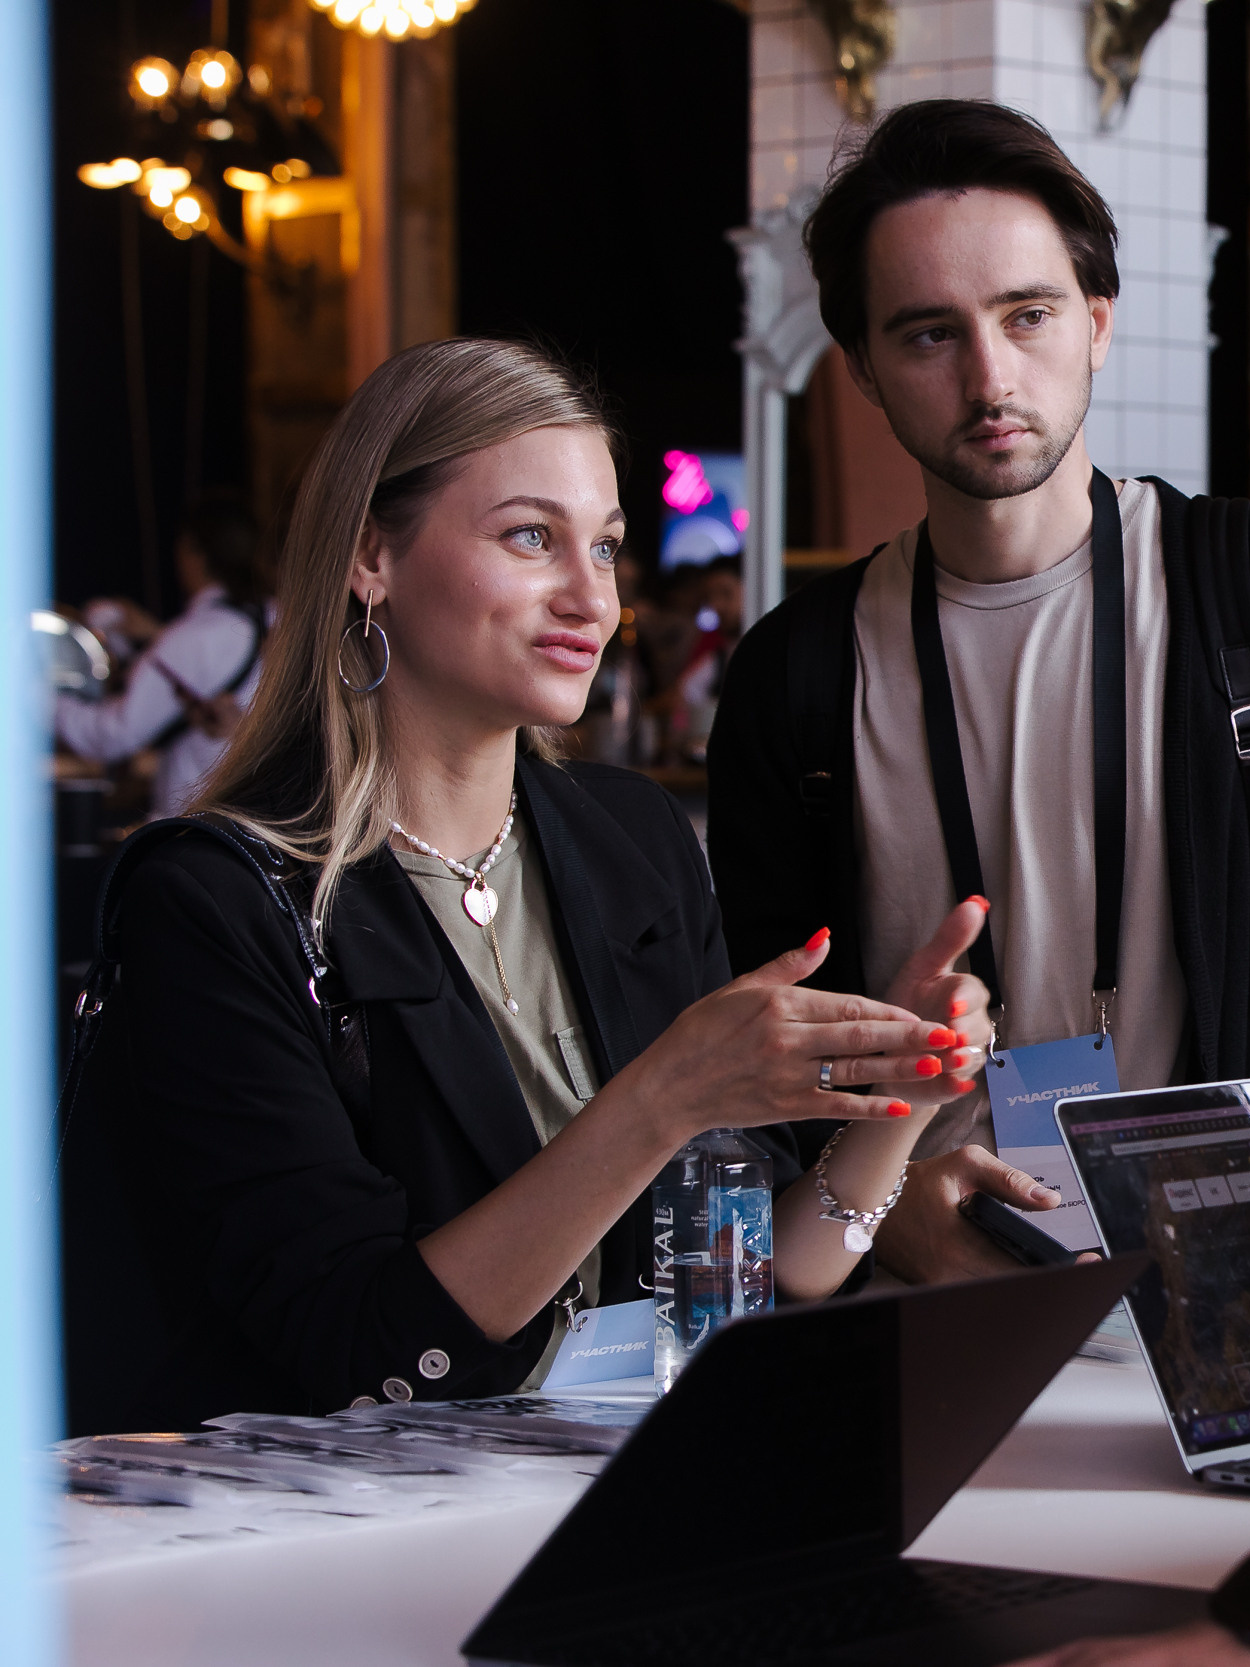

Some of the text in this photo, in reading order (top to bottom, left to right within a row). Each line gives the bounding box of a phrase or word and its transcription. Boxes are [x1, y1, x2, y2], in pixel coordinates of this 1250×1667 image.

[1006, 1081, 1101, 1106] УЧАСТНИК
[654, 1207, 675, 1347] BAIKAL
[569, 1340, 650, 1361] УЧАСТНИК
